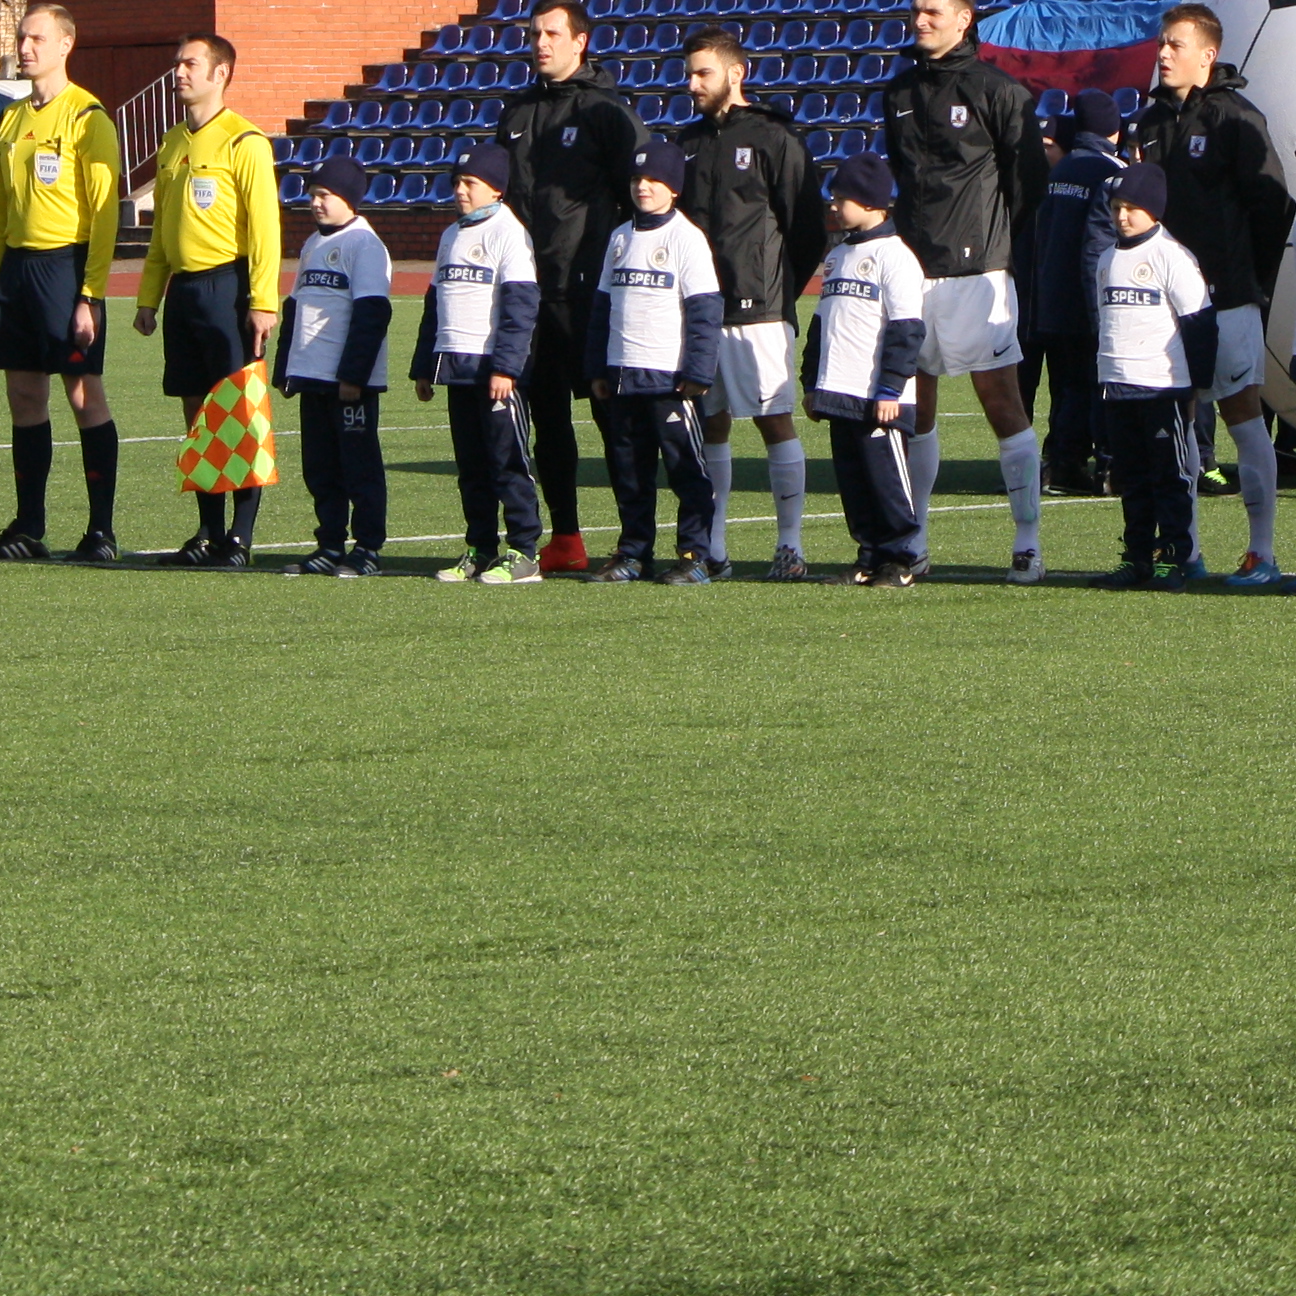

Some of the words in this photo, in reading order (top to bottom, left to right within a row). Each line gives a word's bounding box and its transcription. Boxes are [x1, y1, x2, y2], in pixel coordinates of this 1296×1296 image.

[39, 164, 58, 173] FIFA
[195, 189, 212, 198] FIFA
[964, 247, 971, 258] 7
[740, 298, 753, 309] 27
[343, 405, 367, 426] 94
